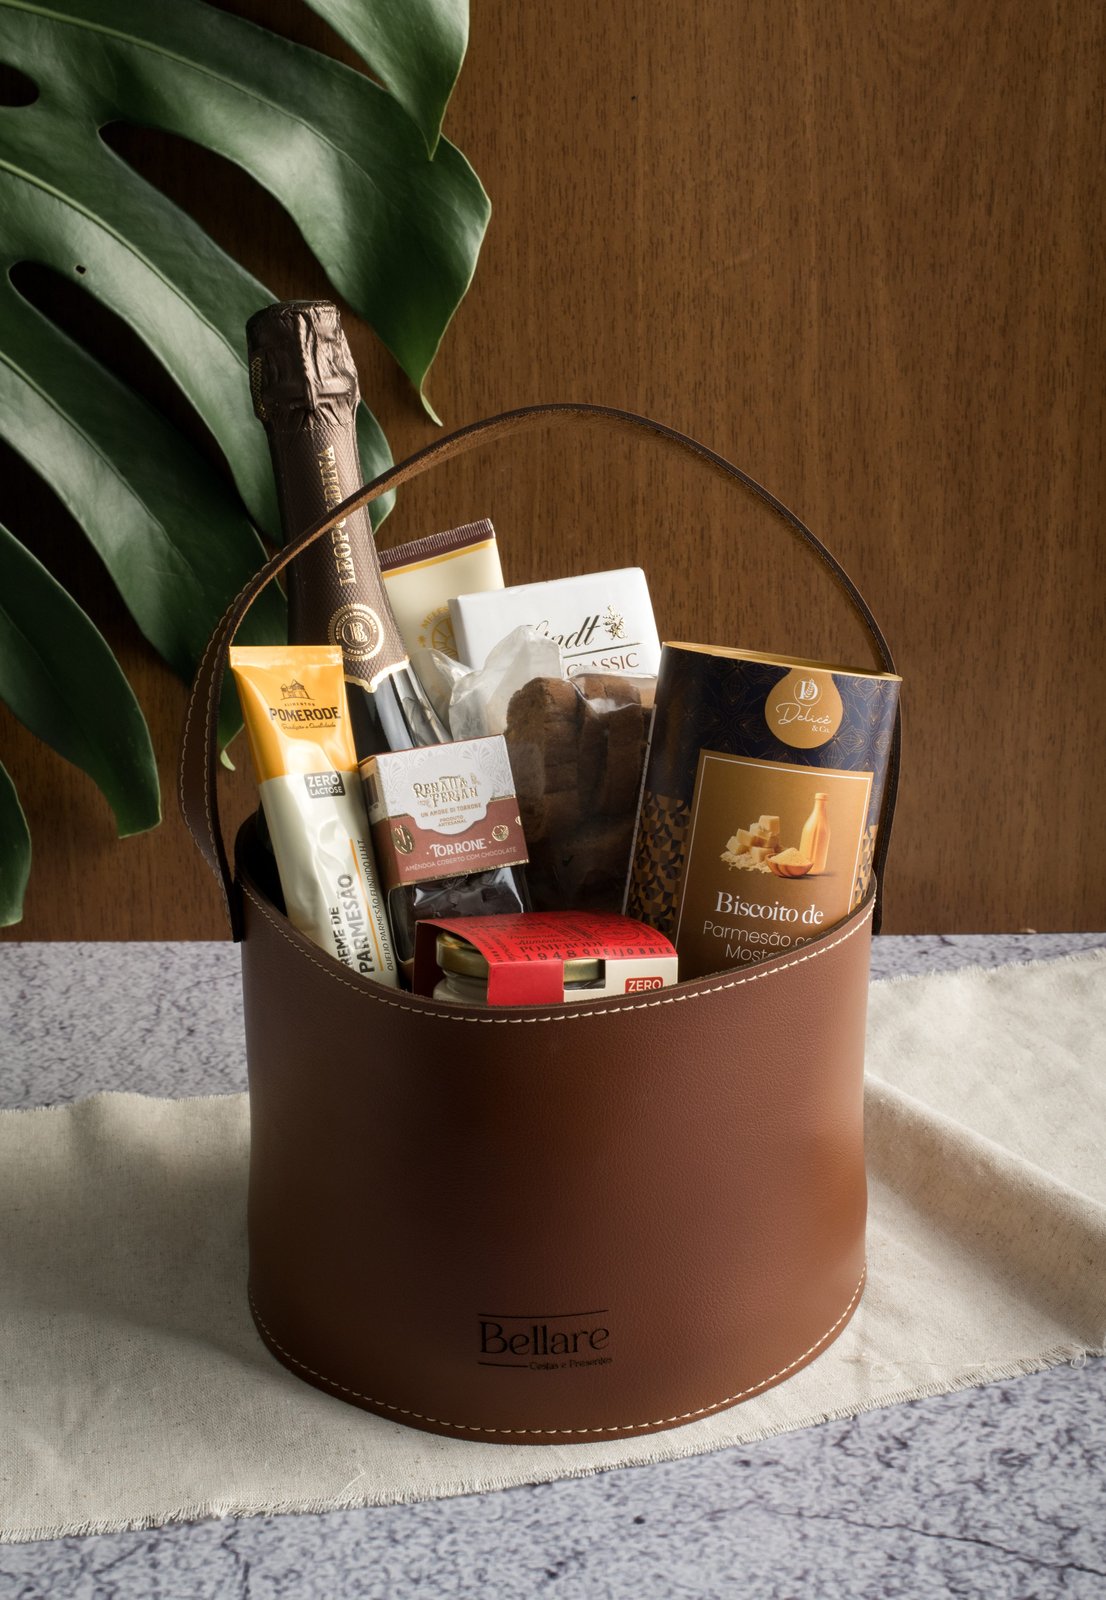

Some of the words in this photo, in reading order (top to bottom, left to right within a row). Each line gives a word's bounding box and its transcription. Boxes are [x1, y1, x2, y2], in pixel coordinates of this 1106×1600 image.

[318, 445, 357, 587] LEOPDINA
[566, 652, 640, 676] CSSIC
[269, 706, 341, 722] POMERODE
[775, 702, 832, 725] Delicê
[306, 774, 340, 788] ZERO
[309, 786, 343, 796] LACTOSE
[429, 838, 487, 858] TORRONE
[436, 857, 466, 866] COBERTO
[466, 853, 481, 861] COM
[481, 846, 517, 858] CHOCOLATE
[329, 907, 342, 925] DE
[715, 891, 798, 924] Biscoito
[801, 903, 825, 925] de
[336, 874, 375, 973] PARMESÃO
[702, 920, 791, 947] Parmesão
[332, 929, 354, 967] REME
[383, 941, 394, 971] QUEIJO
[524, 950, 577, 962] 1948
[582, 947, 634, 957] QUEIJO
[628, 979, 662, 992] ZERO
[479, 1321, 610, 1356] Bellare
